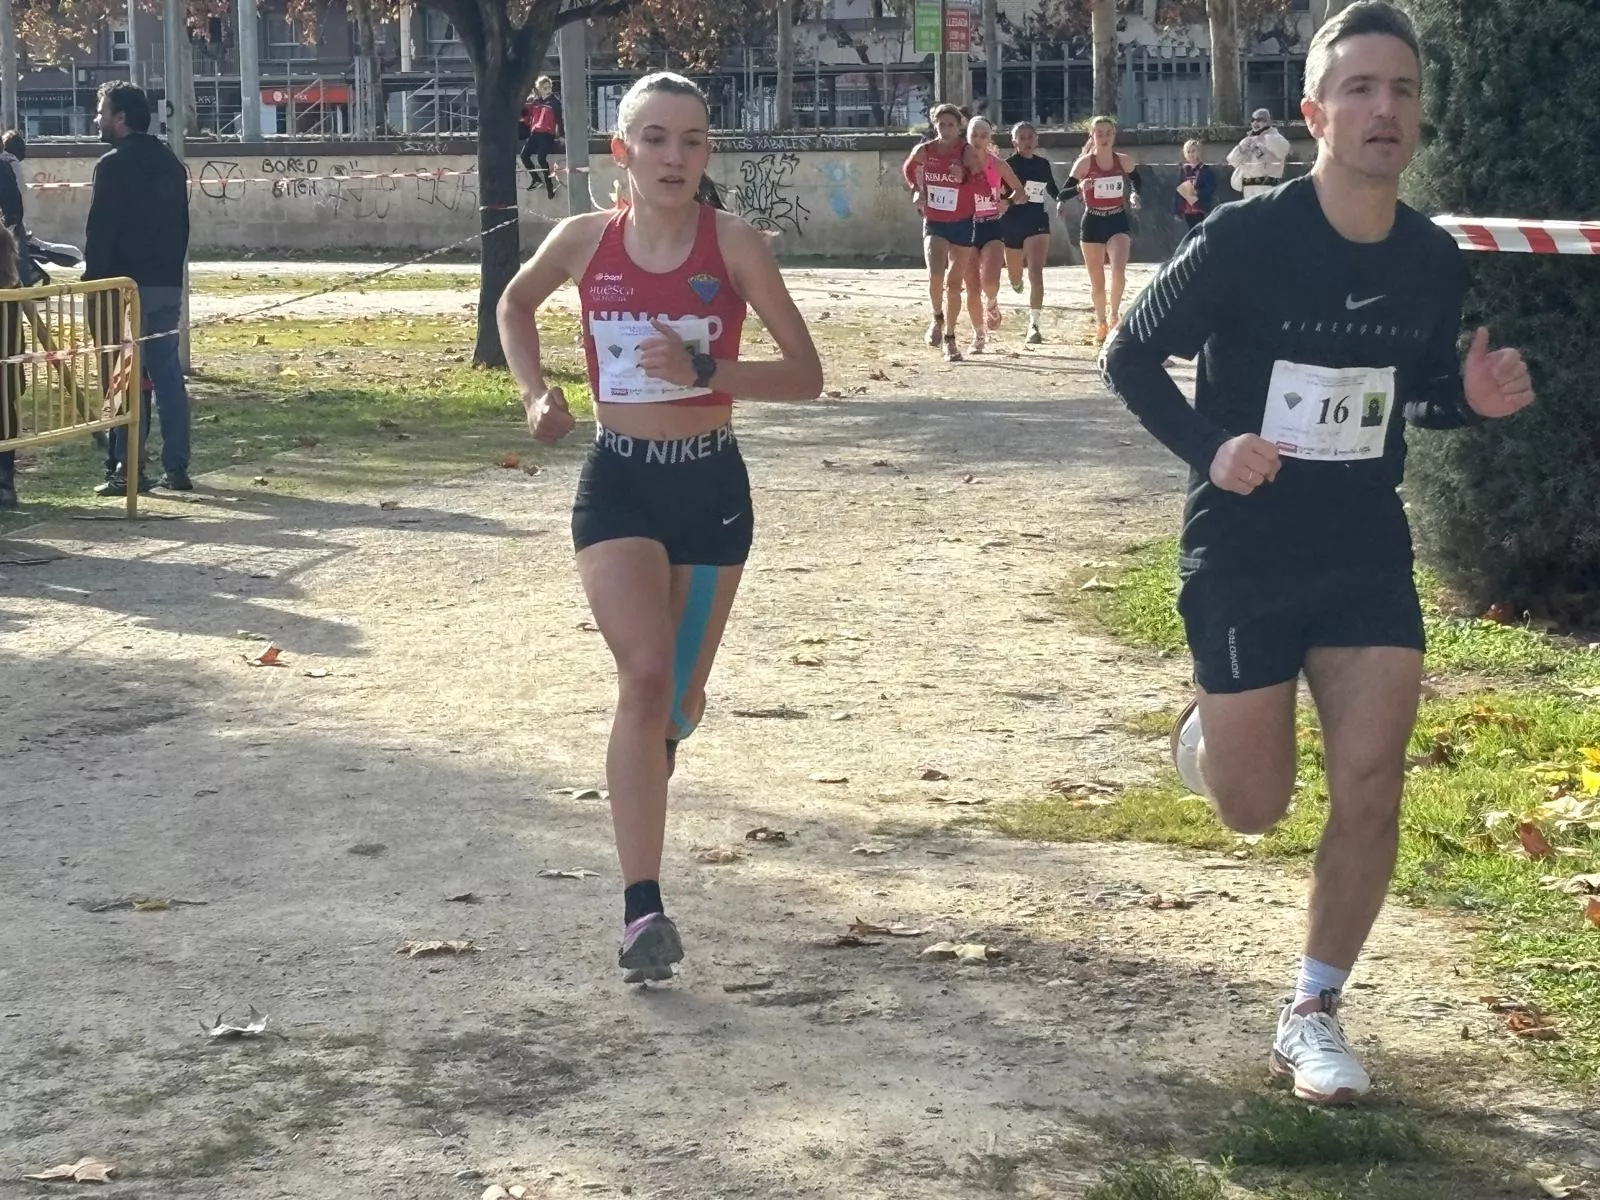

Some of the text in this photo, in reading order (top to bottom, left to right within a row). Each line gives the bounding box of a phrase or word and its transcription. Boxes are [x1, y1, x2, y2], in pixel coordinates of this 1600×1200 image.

[262, 158, 318, 174] BORED
[1315, 394, 1350, 425] 16
[596, 421, 634, 458] PRO
[645, 433, 712, 465] NIKE
